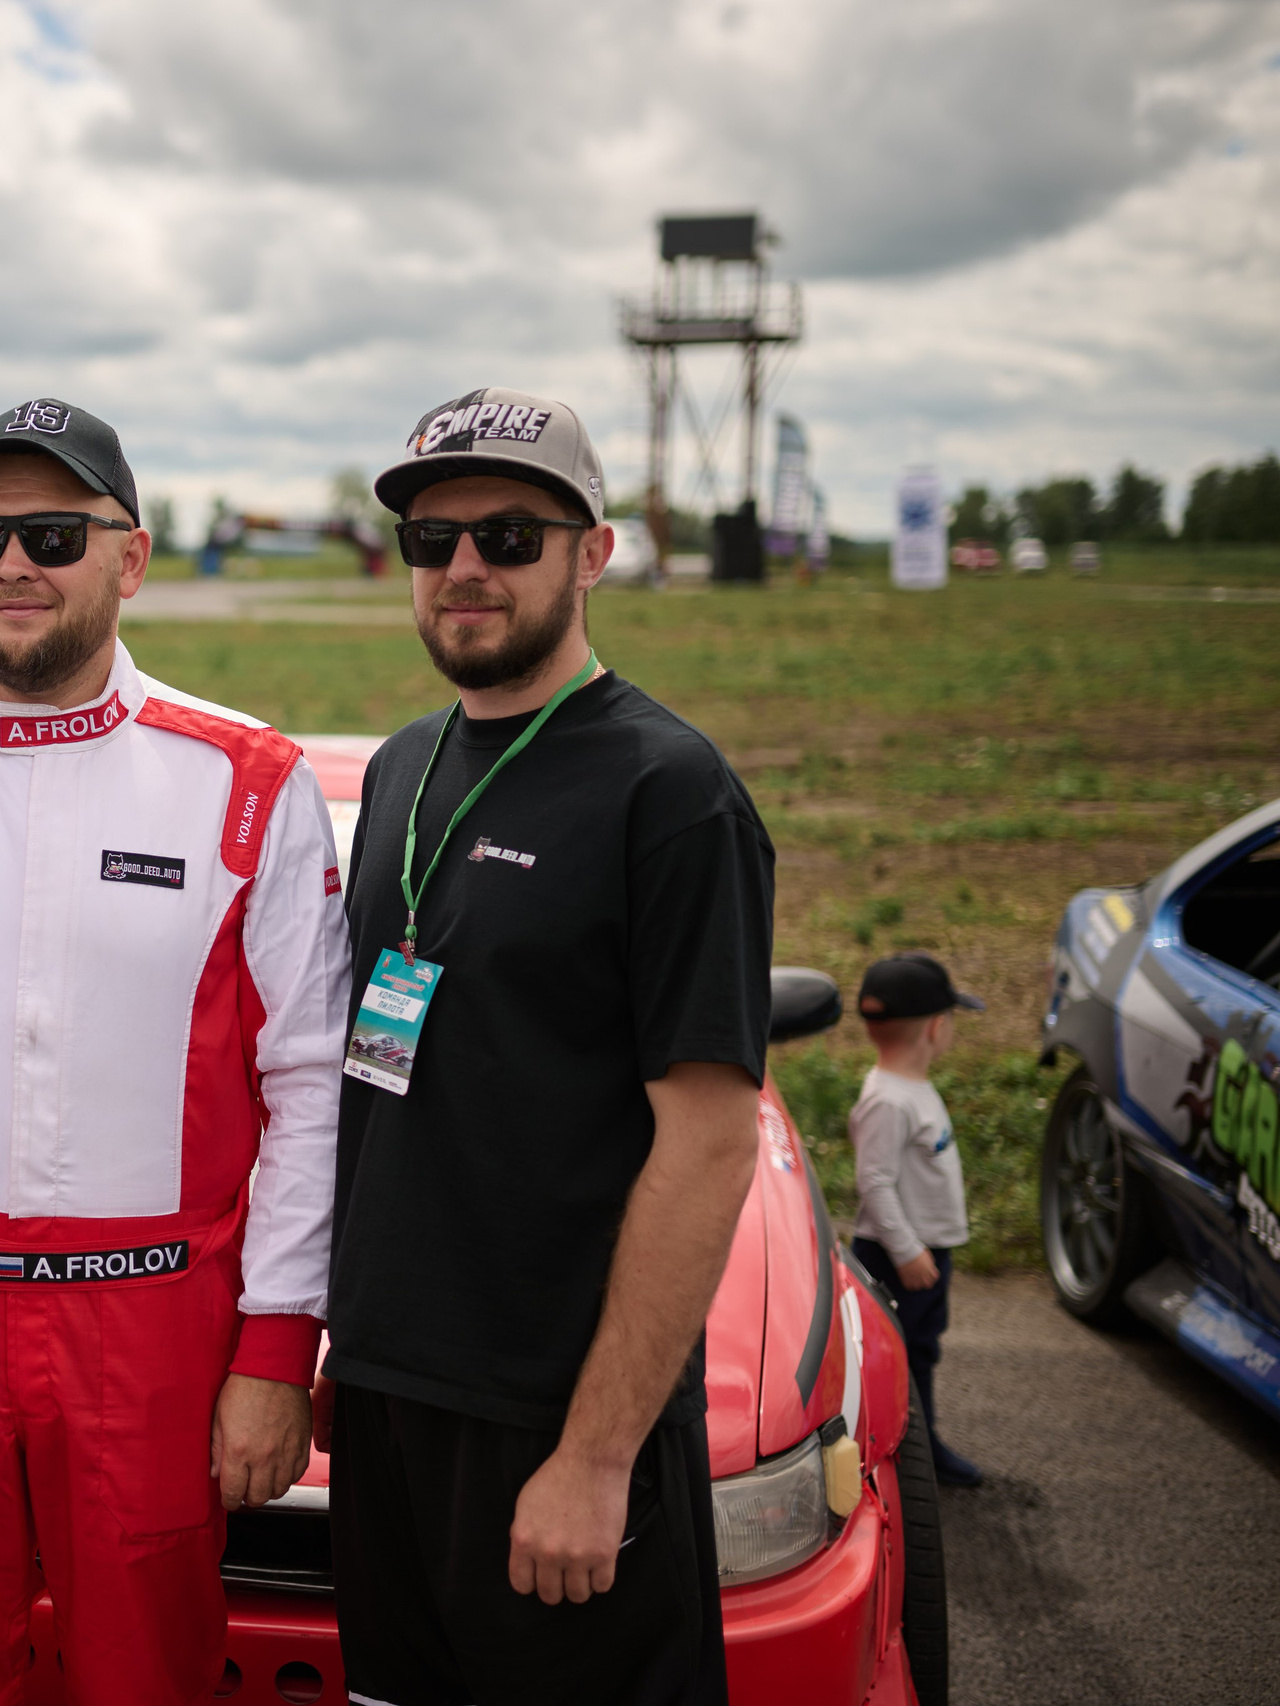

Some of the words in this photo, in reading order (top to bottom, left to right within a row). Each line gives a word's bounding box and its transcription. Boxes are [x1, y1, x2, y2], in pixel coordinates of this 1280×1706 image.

[420, 403, 551, 454] EMPIRE
[473, 427, 539, 441] TEAM
[7, 697, 119, 742] A.FROLOV
[237, 792, 259, 844] VOLSON
[123, 863, 181, 880] GOOD_DEED_AUTO
[377, 990, 411, 1007] КОМАНДА
[377, 1001, 405, 1015] ПИЛОТА
[32, 1245, 182, 1280] A.FROLOV
